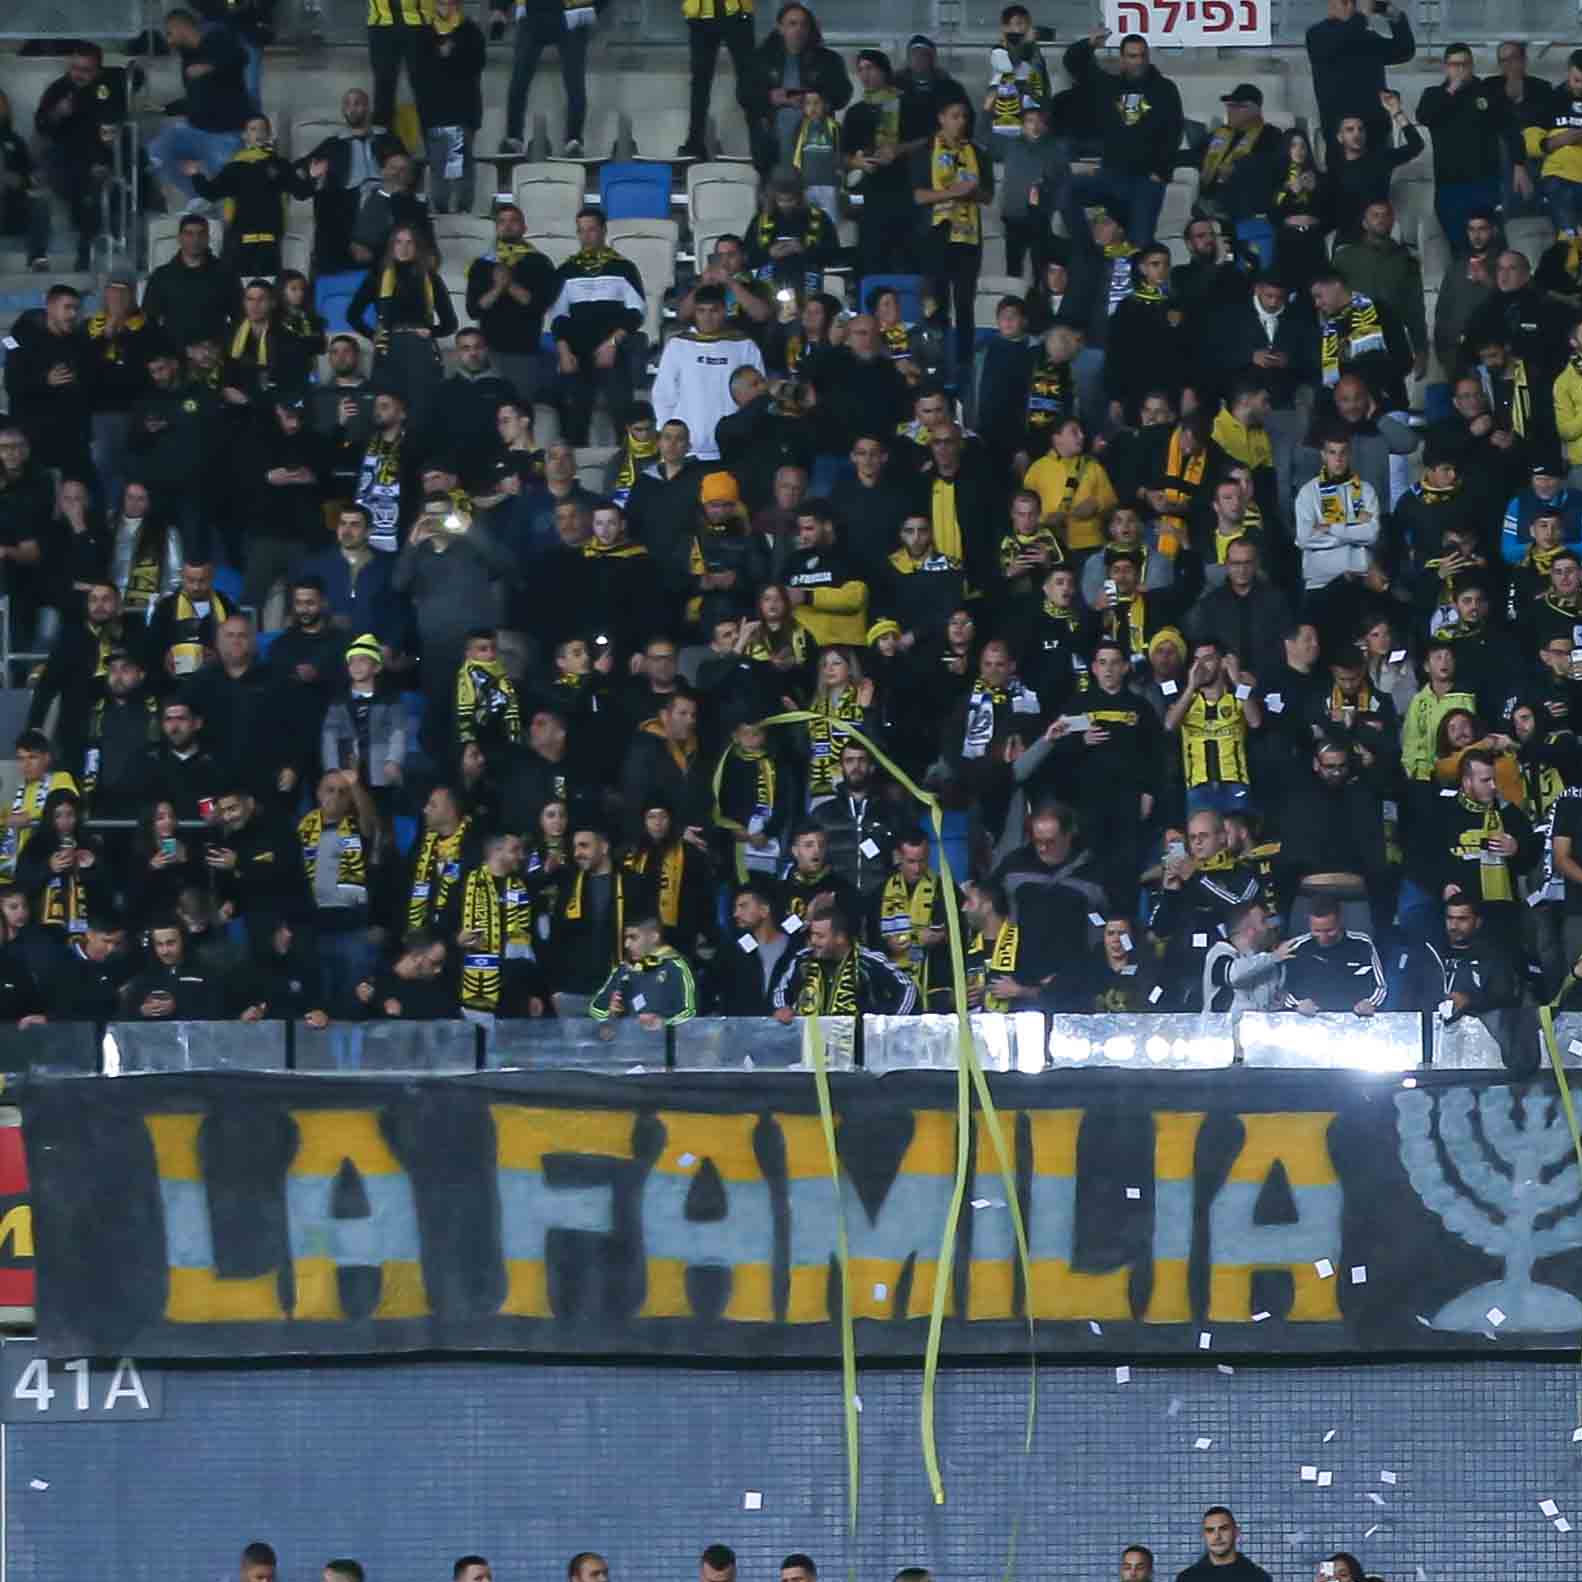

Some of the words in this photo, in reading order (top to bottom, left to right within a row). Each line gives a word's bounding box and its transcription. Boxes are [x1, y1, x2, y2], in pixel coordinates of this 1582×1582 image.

[1117, 0, 1258, 34] נפילה
[145, 1108, 430, 1324] LA
[490, 1103, 1345, 1325] FAMILIA
[13, 1358, 151, 1411] 41A
